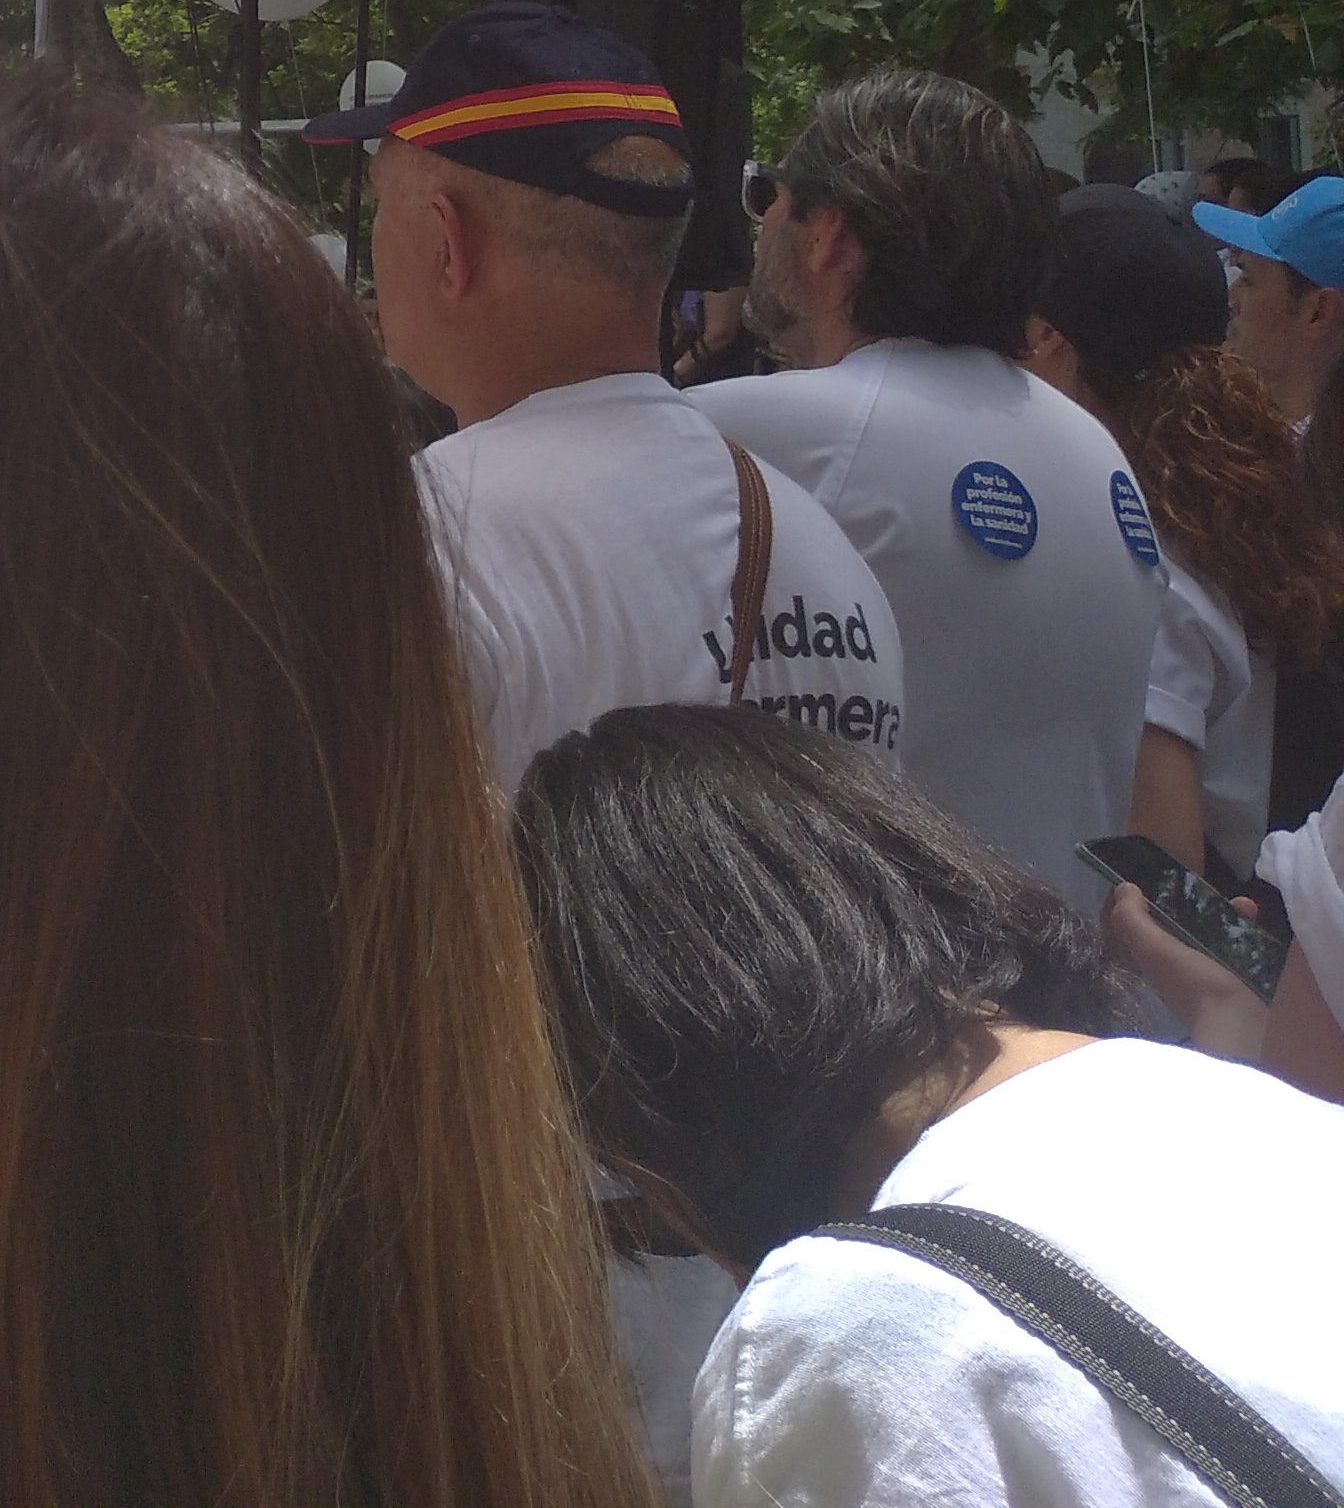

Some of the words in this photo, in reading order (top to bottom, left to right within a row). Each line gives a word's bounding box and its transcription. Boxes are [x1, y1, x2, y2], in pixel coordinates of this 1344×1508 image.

[972, 472, 994, 487] Por
[996, 475, 1010, 489] la
[965, 487, 1023, 506] profesión
[961, 500, 1024, 520] enfermera
[1025, 510, 1033, 524] y
[969, 513, 985, 528] la
[986, 515, 1029, 536] sanidad
